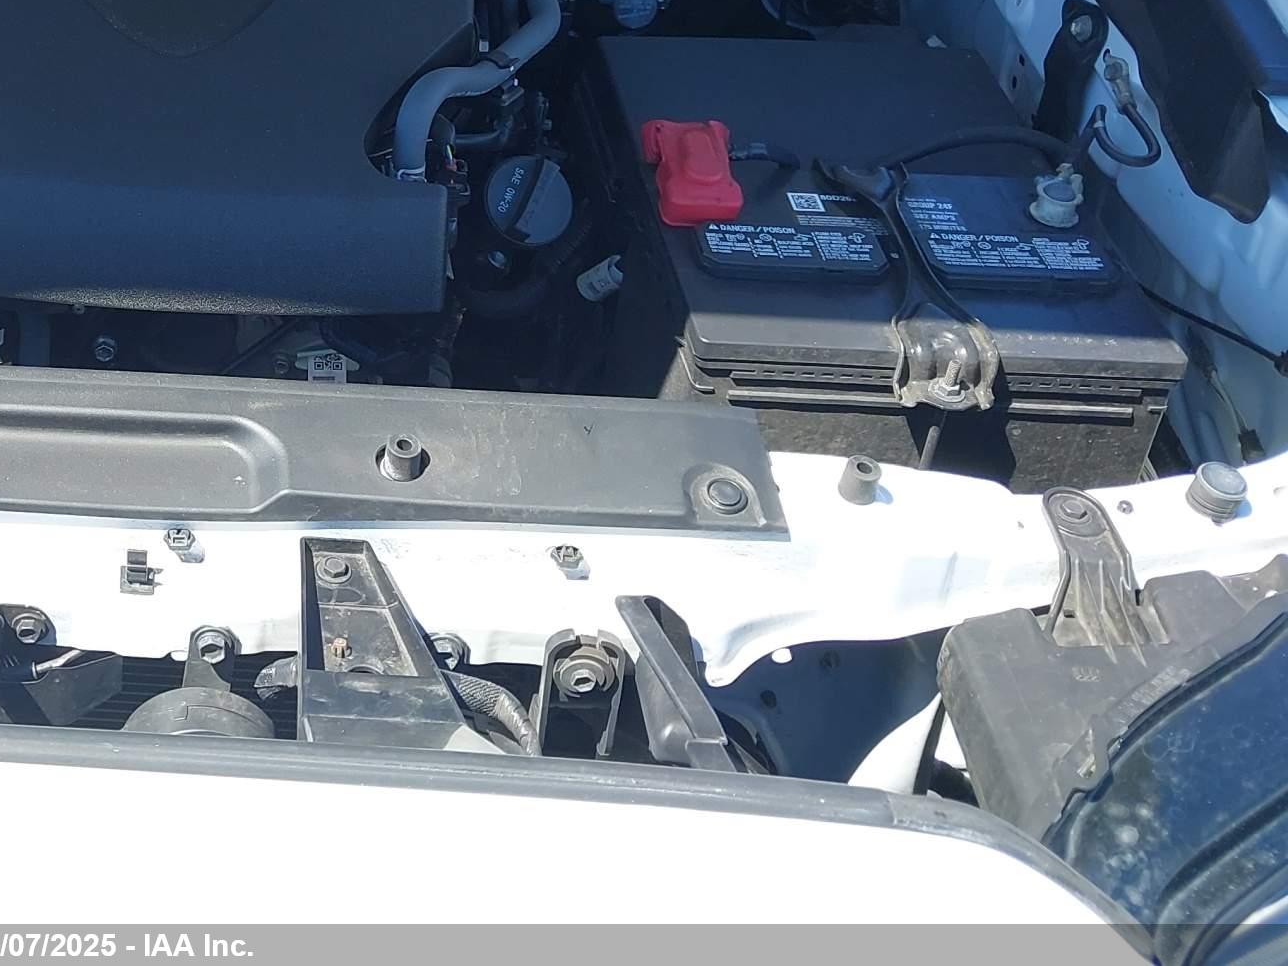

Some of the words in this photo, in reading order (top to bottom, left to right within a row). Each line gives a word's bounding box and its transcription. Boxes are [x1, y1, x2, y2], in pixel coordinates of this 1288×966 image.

[512, 167, 524, 185] SAE
[497, 187, 516, 213] 0W-20
[719, 223, 755, 233] DANGER
[762, 226, 796, 235] POISON
[940, 233, 977, 242] DANGER
[984, 235, 1019, 244] POISON
